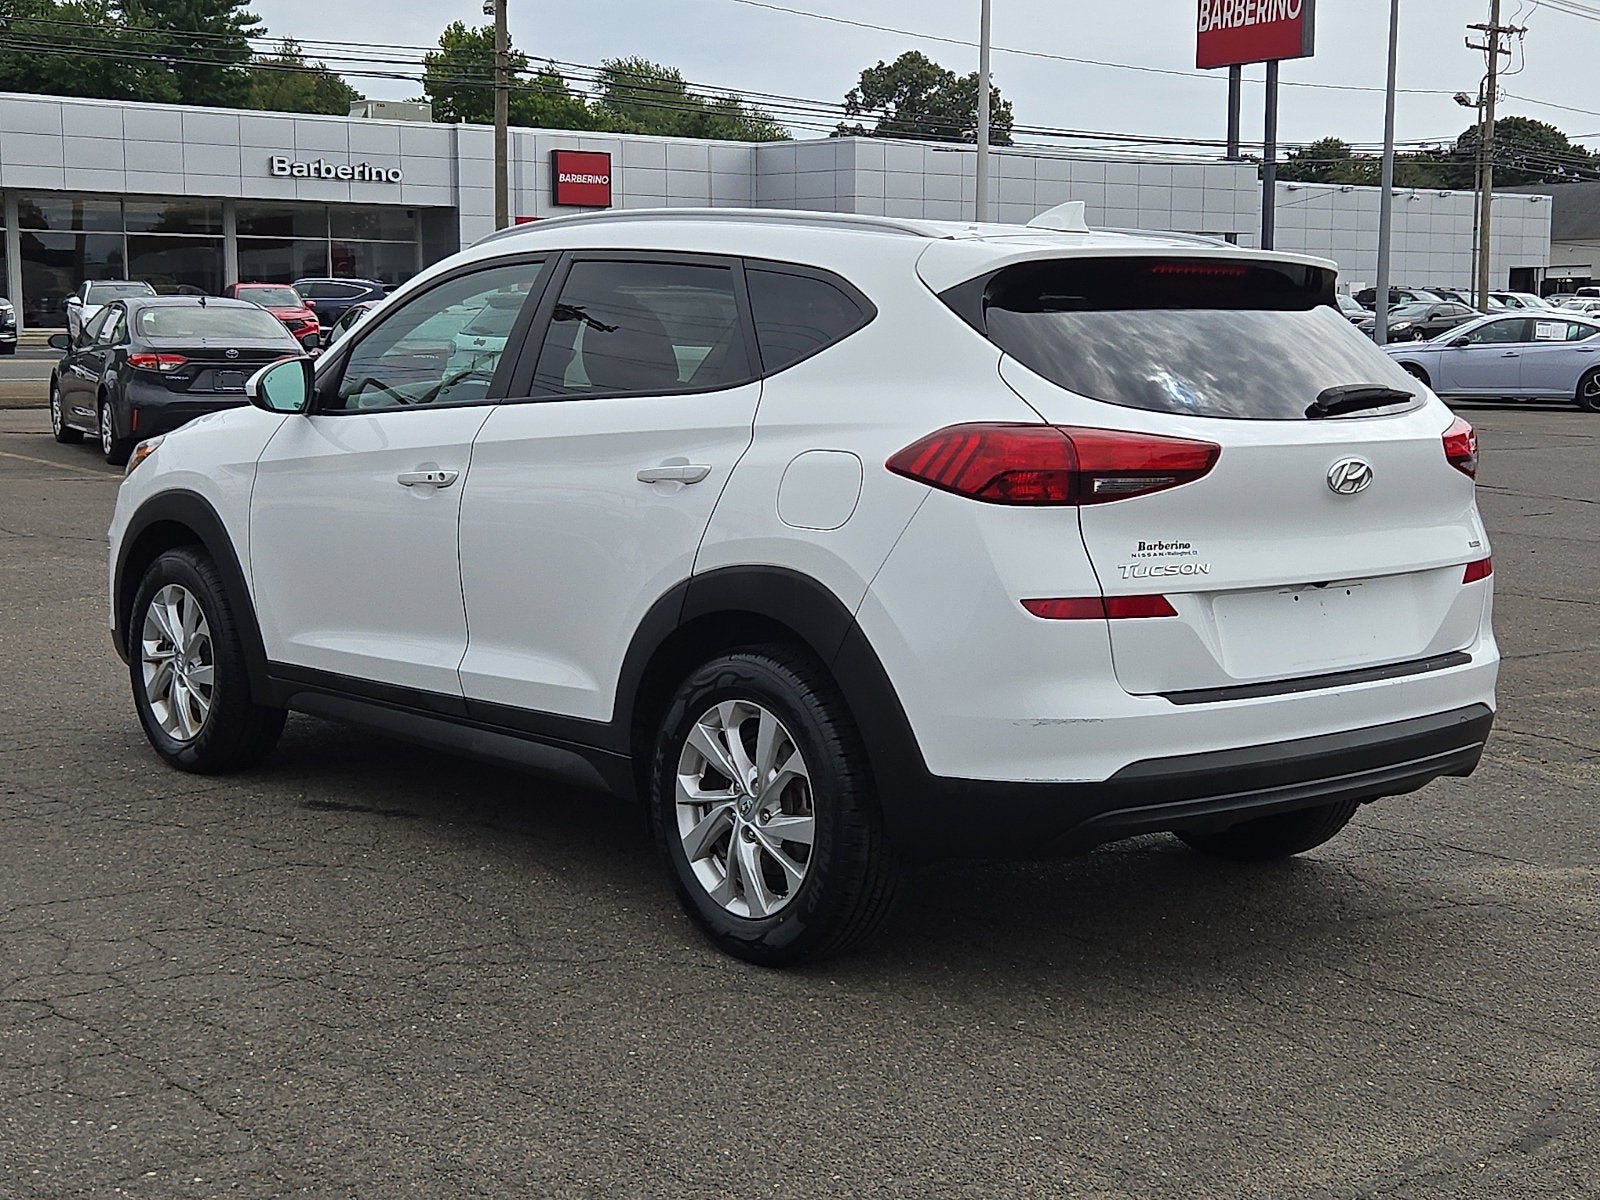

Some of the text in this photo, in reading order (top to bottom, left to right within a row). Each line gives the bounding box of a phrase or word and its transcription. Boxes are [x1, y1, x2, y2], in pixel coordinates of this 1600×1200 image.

[1199, 0, 1302, 32] BARBERINO
[271, 155, 403, 183] Barberino
[558, 173, 609, 185] BARBERINO
[1138, 540, 1190, 551] Barberino
